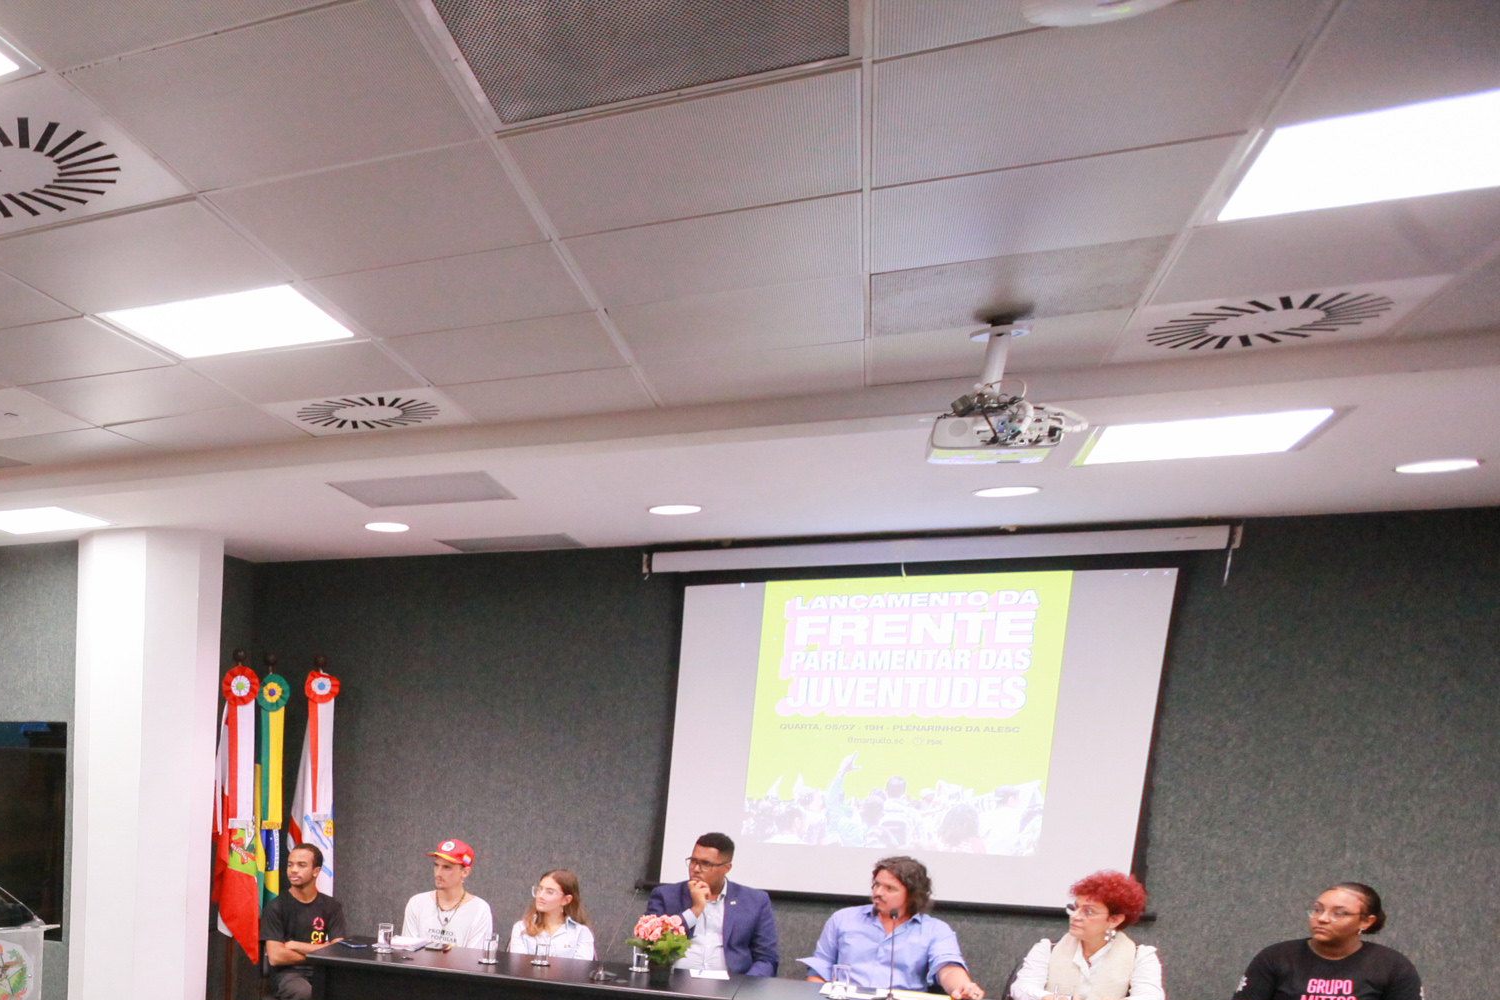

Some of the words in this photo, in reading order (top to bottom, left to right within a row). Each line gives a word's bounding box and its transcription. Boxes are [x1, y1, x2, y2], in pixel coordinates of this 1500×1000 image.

[795, 590, 990, 612] LANÇAMENTO
[998, 589, 1040, 606] DA
[794, 610, 1037, 646] FRENTE
[790, 649, 971, 671] PARLAMENTAR
[978, 648, 1032, 671] DAS
[785, 675, 1029, 710] JUVENTUDES
[779, 723, 822, 731] QUARTA,
[1306, 978, 1354, 995] GRUPO
